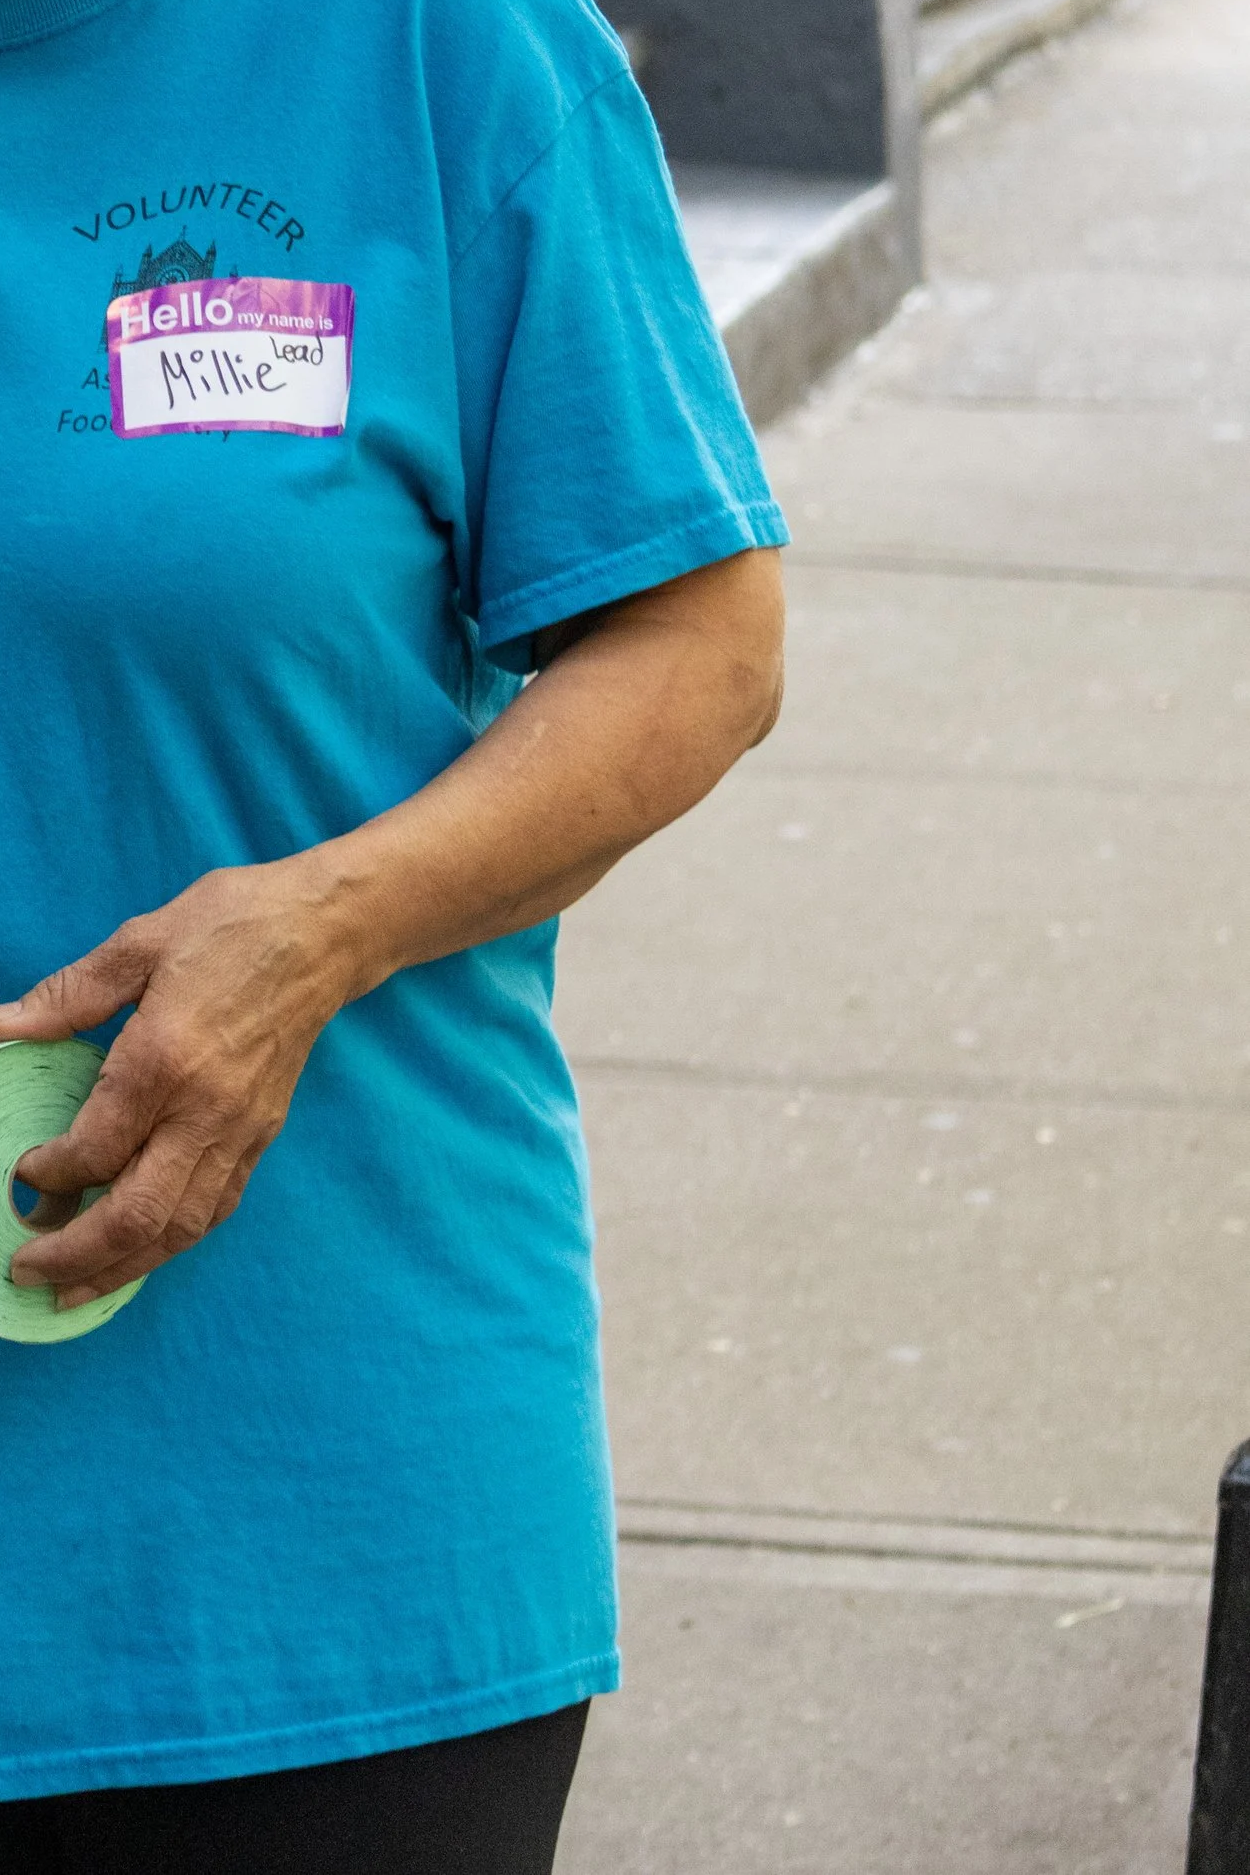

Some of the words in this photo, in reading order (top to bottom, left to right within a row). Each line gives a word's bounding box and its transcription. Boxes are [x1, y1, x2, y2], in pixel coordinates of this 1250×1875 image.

[72, 182, 305, 253] VOLUNTEER
[120, 291, 234, 338] Hello
[237, 311, 264, 328] my
[268, 313, 314, 329] name
[318, 315, 334, 331] is
[269, 332, 324, 366] Lead
[160, 349, 287, 410] Millie
